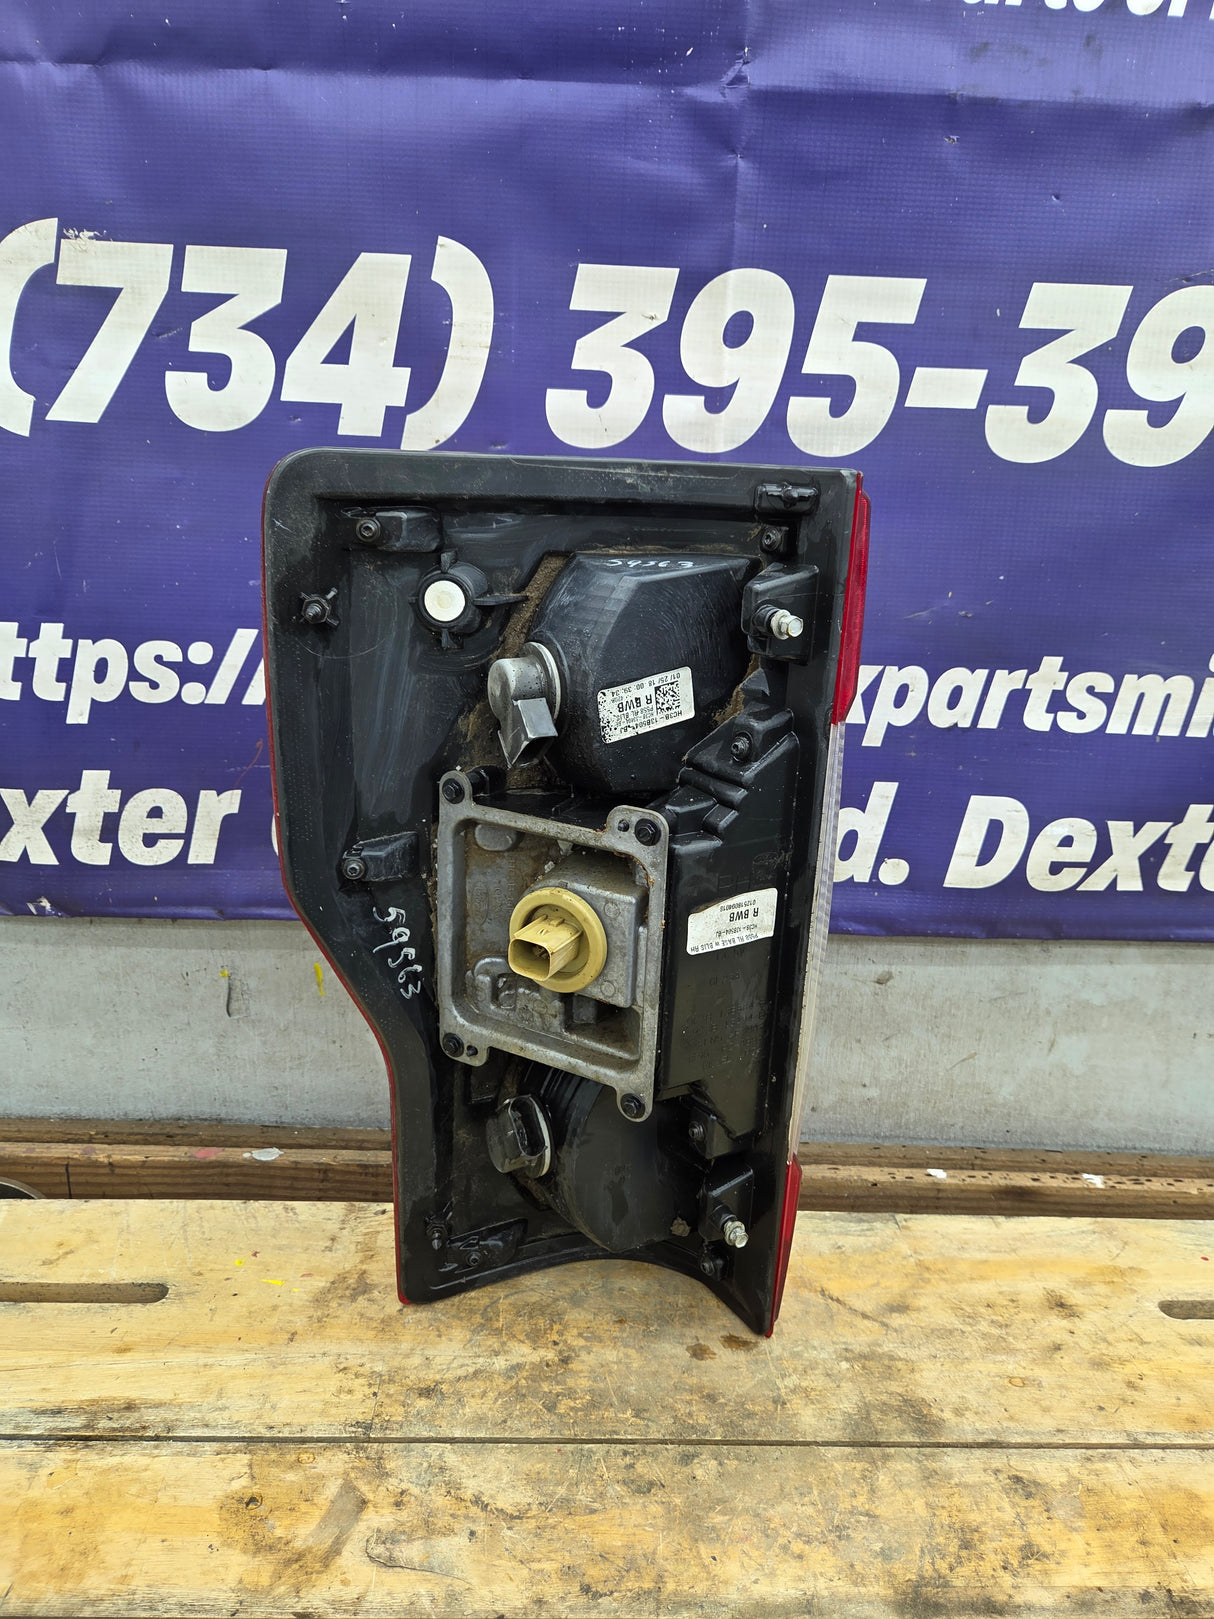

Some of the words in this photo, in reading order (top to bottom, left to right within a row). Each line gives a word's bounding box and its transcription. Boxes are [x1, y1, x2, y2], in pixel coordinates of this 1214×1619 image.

[0, 217, 494, 450] (734)
[545, 263, 1214, 467] 395-39
[617, 697, 642, 713] BWB
[645, 694, 653, 705] R
[942, 795, 1214, 893] Dext
[729, 911, 750, 923] BWB
[752, 907, 760, 918] R
